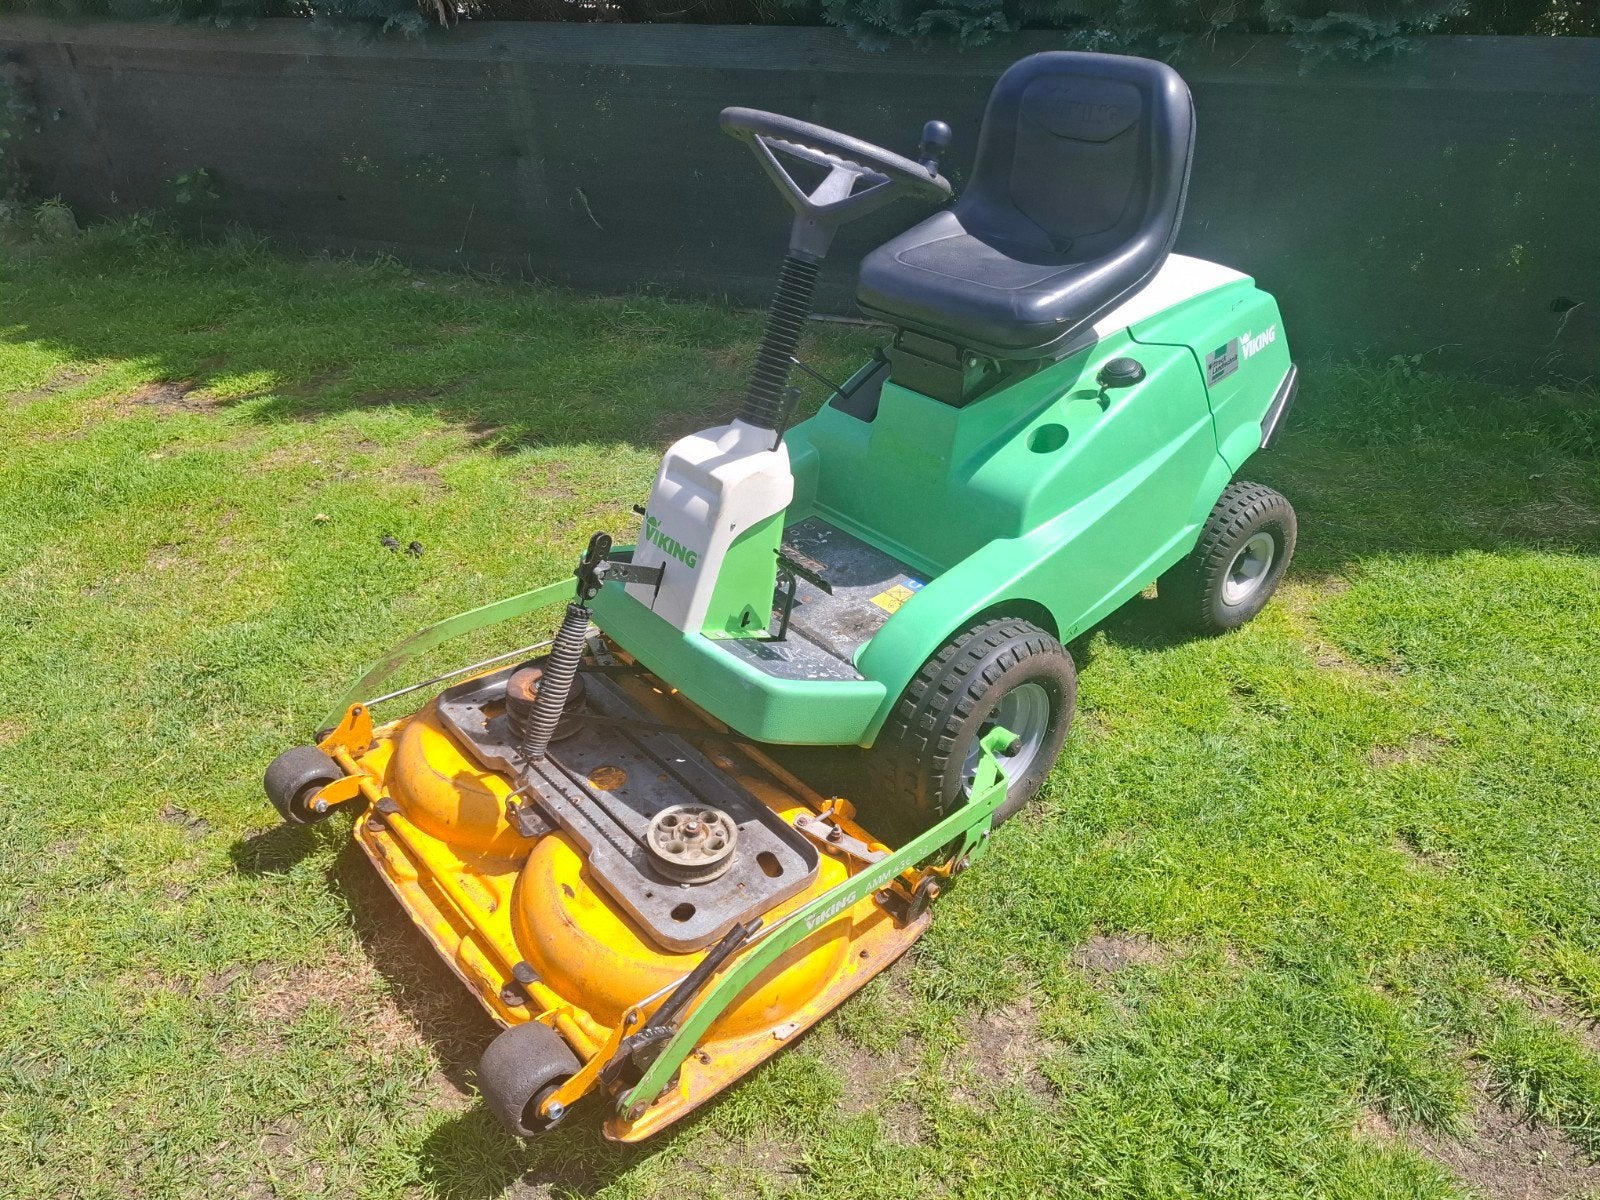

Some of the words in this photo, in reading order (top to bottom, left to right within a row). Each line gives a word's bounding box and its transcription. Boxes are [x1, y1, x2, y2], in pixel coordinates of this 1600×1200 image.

[1242, 324, 1276, 360] VIKING
[645, 523, 698, 569] VIKING
[804, 890, 857, 930] VIKING
[865, 871, 891, 894] AMM
